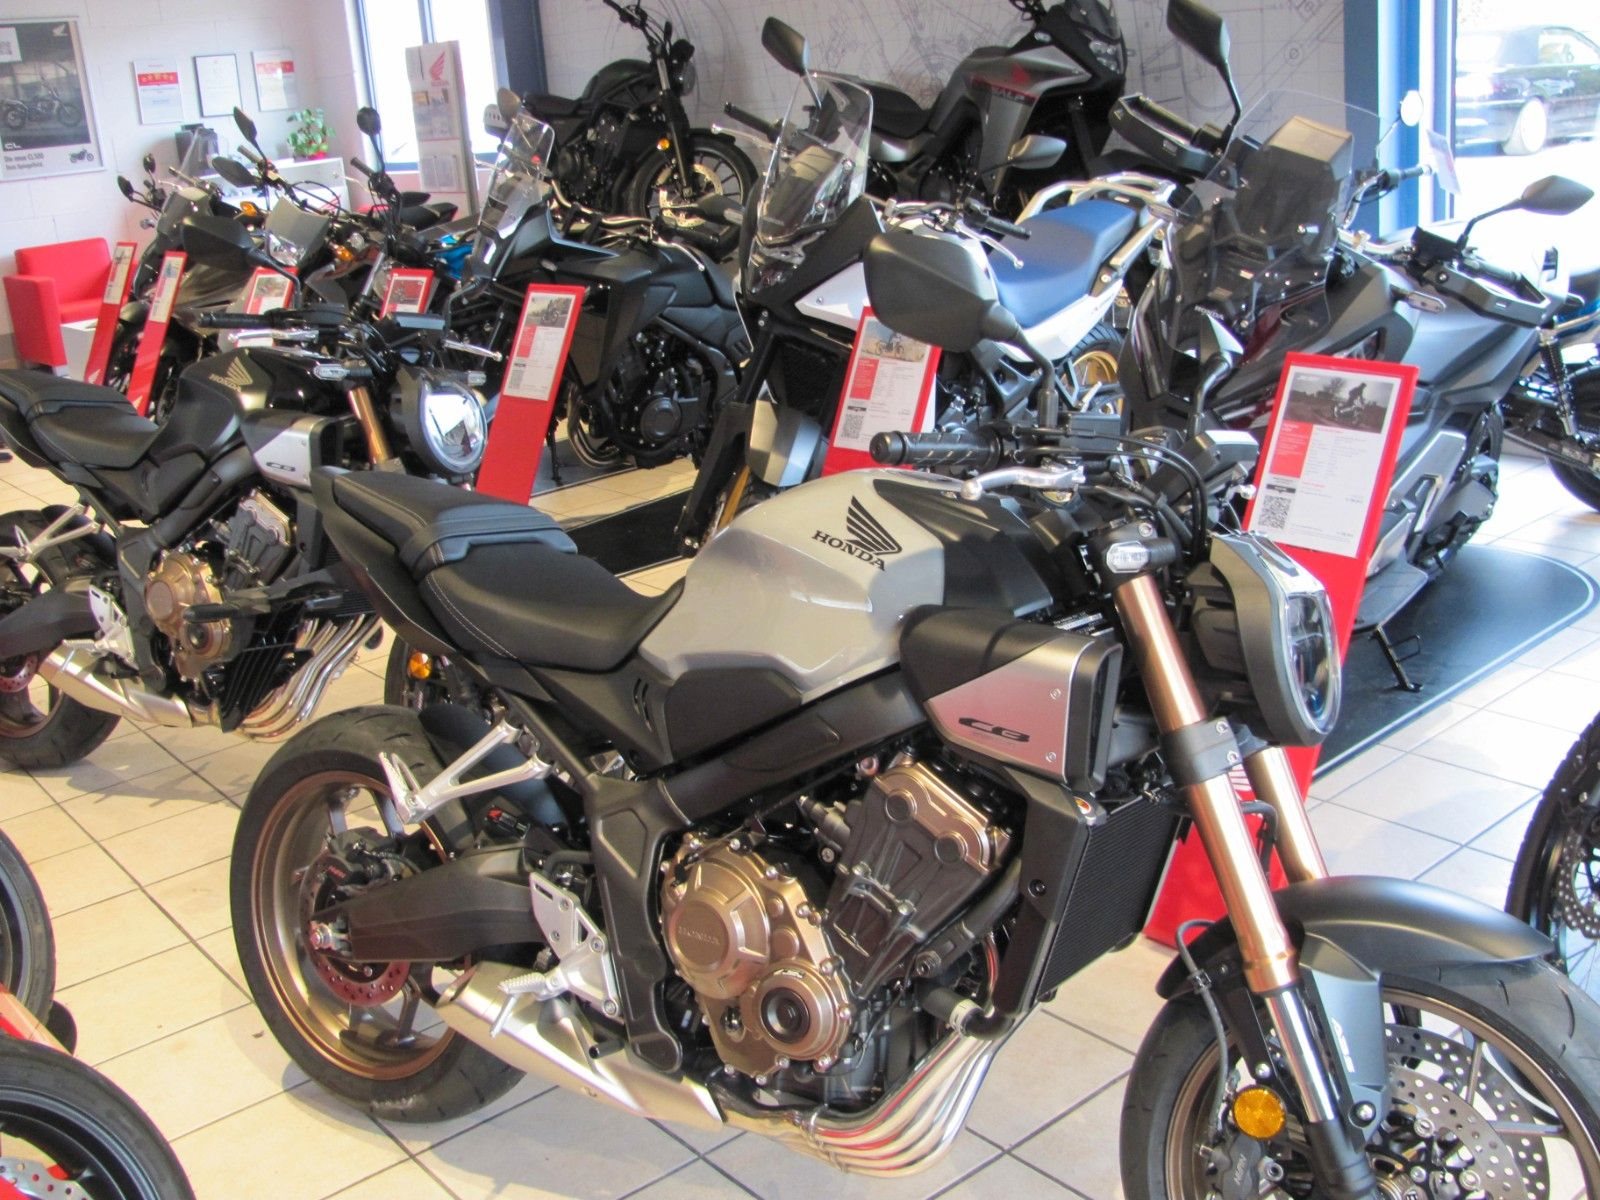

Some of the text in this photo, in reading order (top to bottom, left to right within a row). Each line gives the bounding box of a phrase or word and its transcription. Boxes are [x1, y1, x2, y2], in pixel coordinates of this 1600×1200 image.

[1194, 305, 1224, 321] HONDA
[208, 373, 242, 393] HONDA
[266, 462, 296, 472] CB
[812, 530, 885, 571] HONDA
[959, 717, 1030, 742] CB
